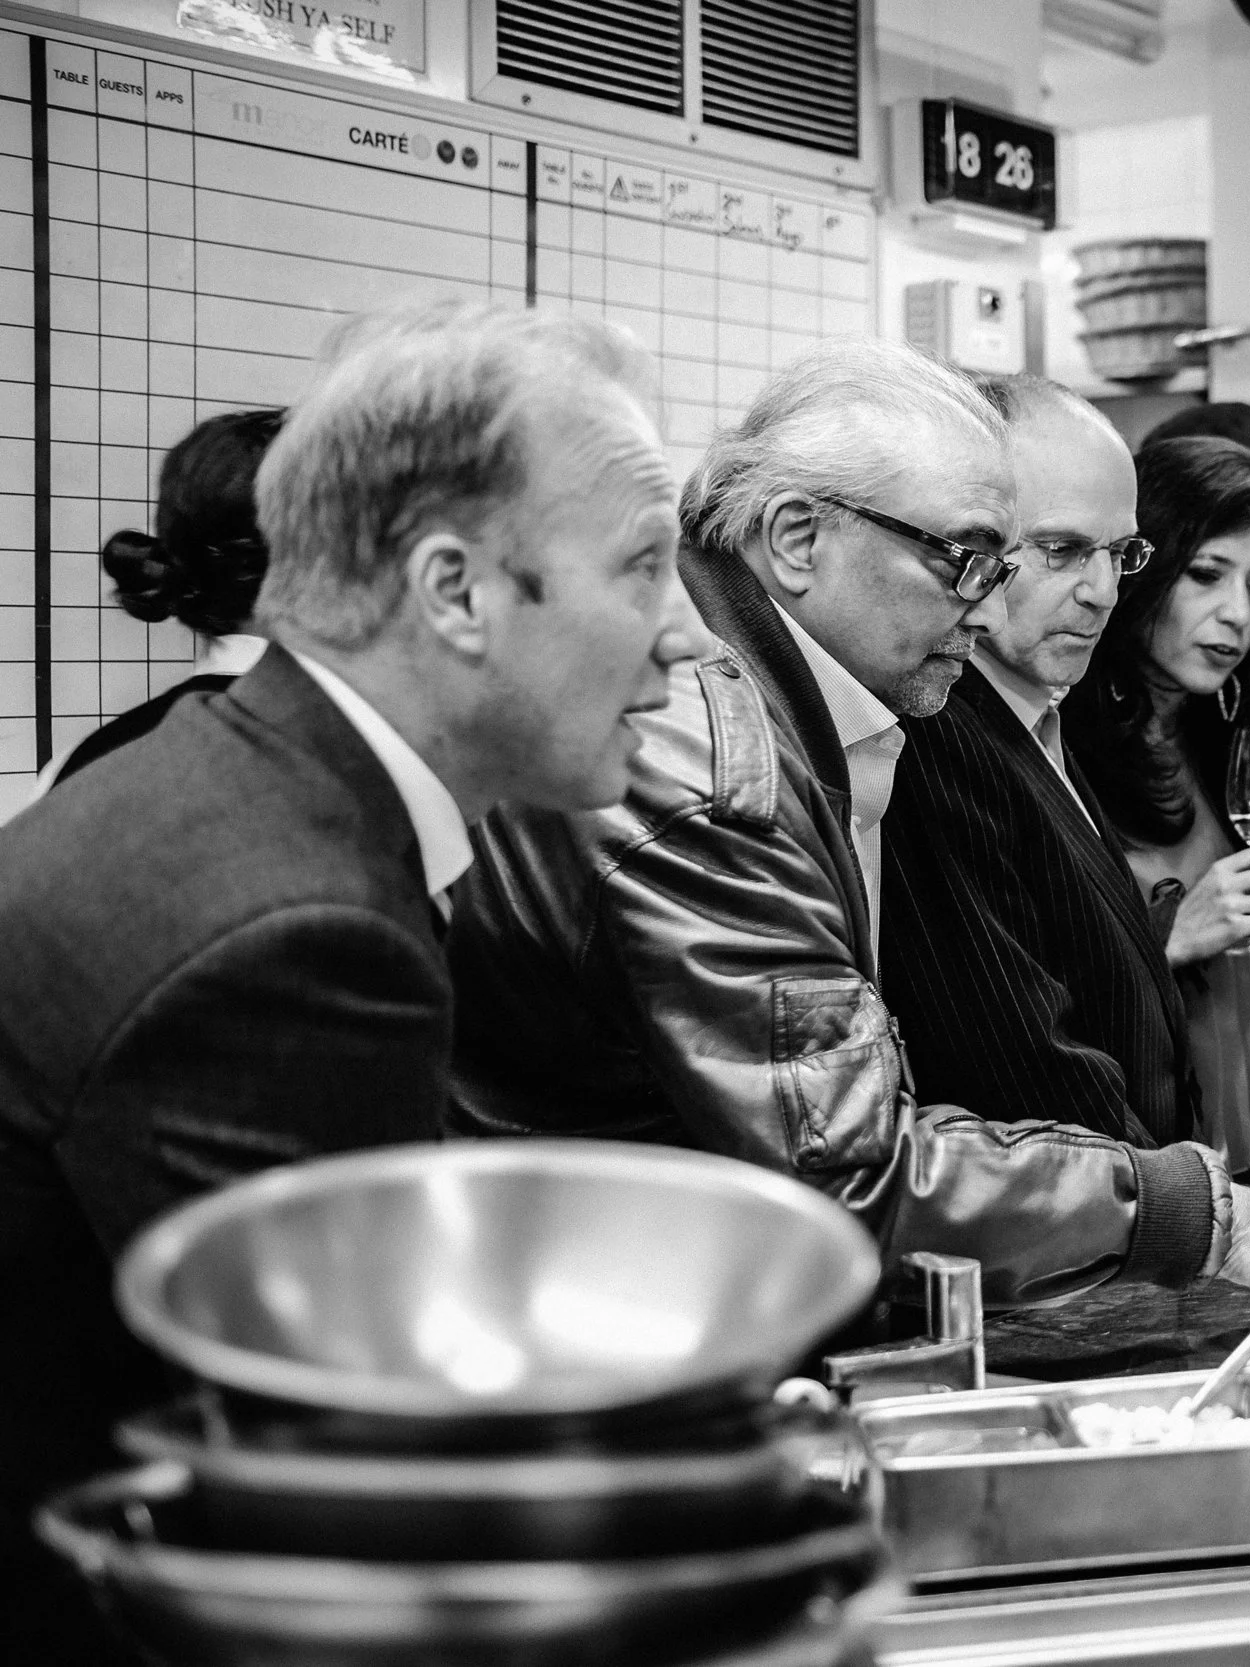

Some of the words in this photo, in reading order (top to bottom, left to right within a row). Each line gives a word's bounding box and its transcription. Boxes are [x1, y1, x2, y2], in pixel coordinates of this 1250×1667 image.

[341, 14, 396, 45] SELF
[53, 68, 90, 86] TABLE
[99, 78, 144, 97] GUESTS
[154, 90, 184, 105] APPS
[349, 126, 409, 155] CARTÉ
